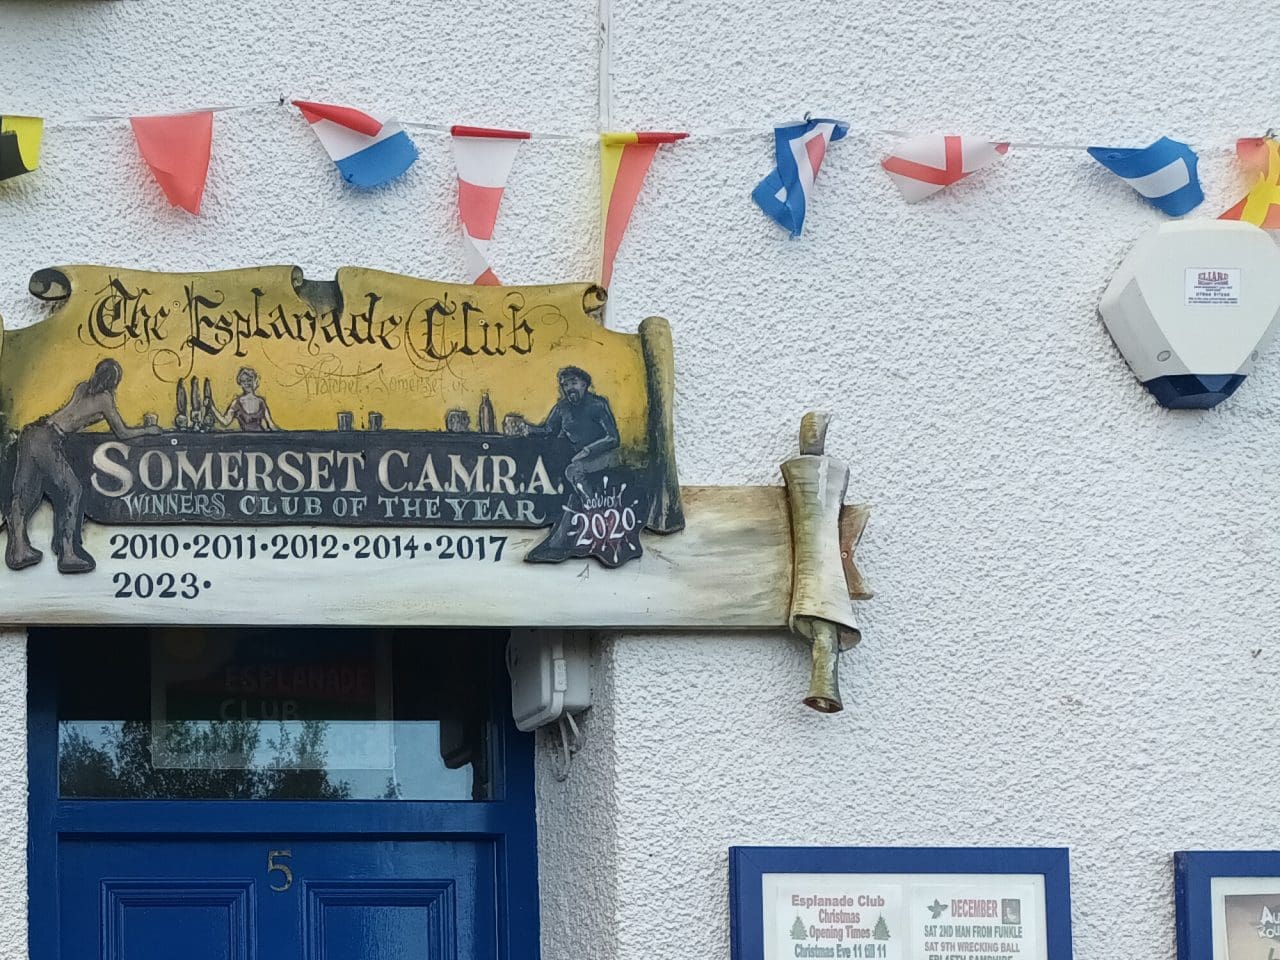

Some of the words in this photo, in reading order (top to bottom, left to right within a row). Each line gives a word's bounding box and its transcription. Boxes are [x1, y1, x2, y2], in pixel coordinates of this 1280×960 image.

[88, 276, 171, 349] The
[181, 282, 402, 357] Esplanade
[405, 292, 534, 371] Club
[91, 441, 366, 497] SOMERSET
[121, 492, 226, 520] WINNERS
[239, 494, 322, 516] CLUB
[333, 496, 367, 517] OF
[378, 497, 441, 518] THE
[445, 498, 545, 524] YEAR
[571, 507, 635, 546] 2020
[219, 698, 300, 721] CLUB
[268, 850, 293, 891] 5
[791, 894, 854, 909] Esplanade
[857, 895, 885, 907] Club
[951, 899, 998, 918] DECEMBER
[818, 908, 861, 924] Christmas
[809, 924, 844, 942] Opening
[845, 924, 871, 939] Times
[924, 924, 938, 937] SAT
[939, 925, 953, 937] 2ND
[955, 925, 970, 938] MAN
[972, 926, 992, 938] FROM
[994, 926, 1023, 938] FUNKLE
[794, 943, 835, 958] Christmas
[836, 943, 851, 958] Eve
[853, 943, 862, 958] 11
[864, 943, 876, 958] till
[877, 943, 887, 958] 11
[924, 941, 939, 952] SAT
[940, 941, 956, 952] 9TH
[957, 942, 999, 953] WRECKING
[1000, 942, 1021, 953] BALL
